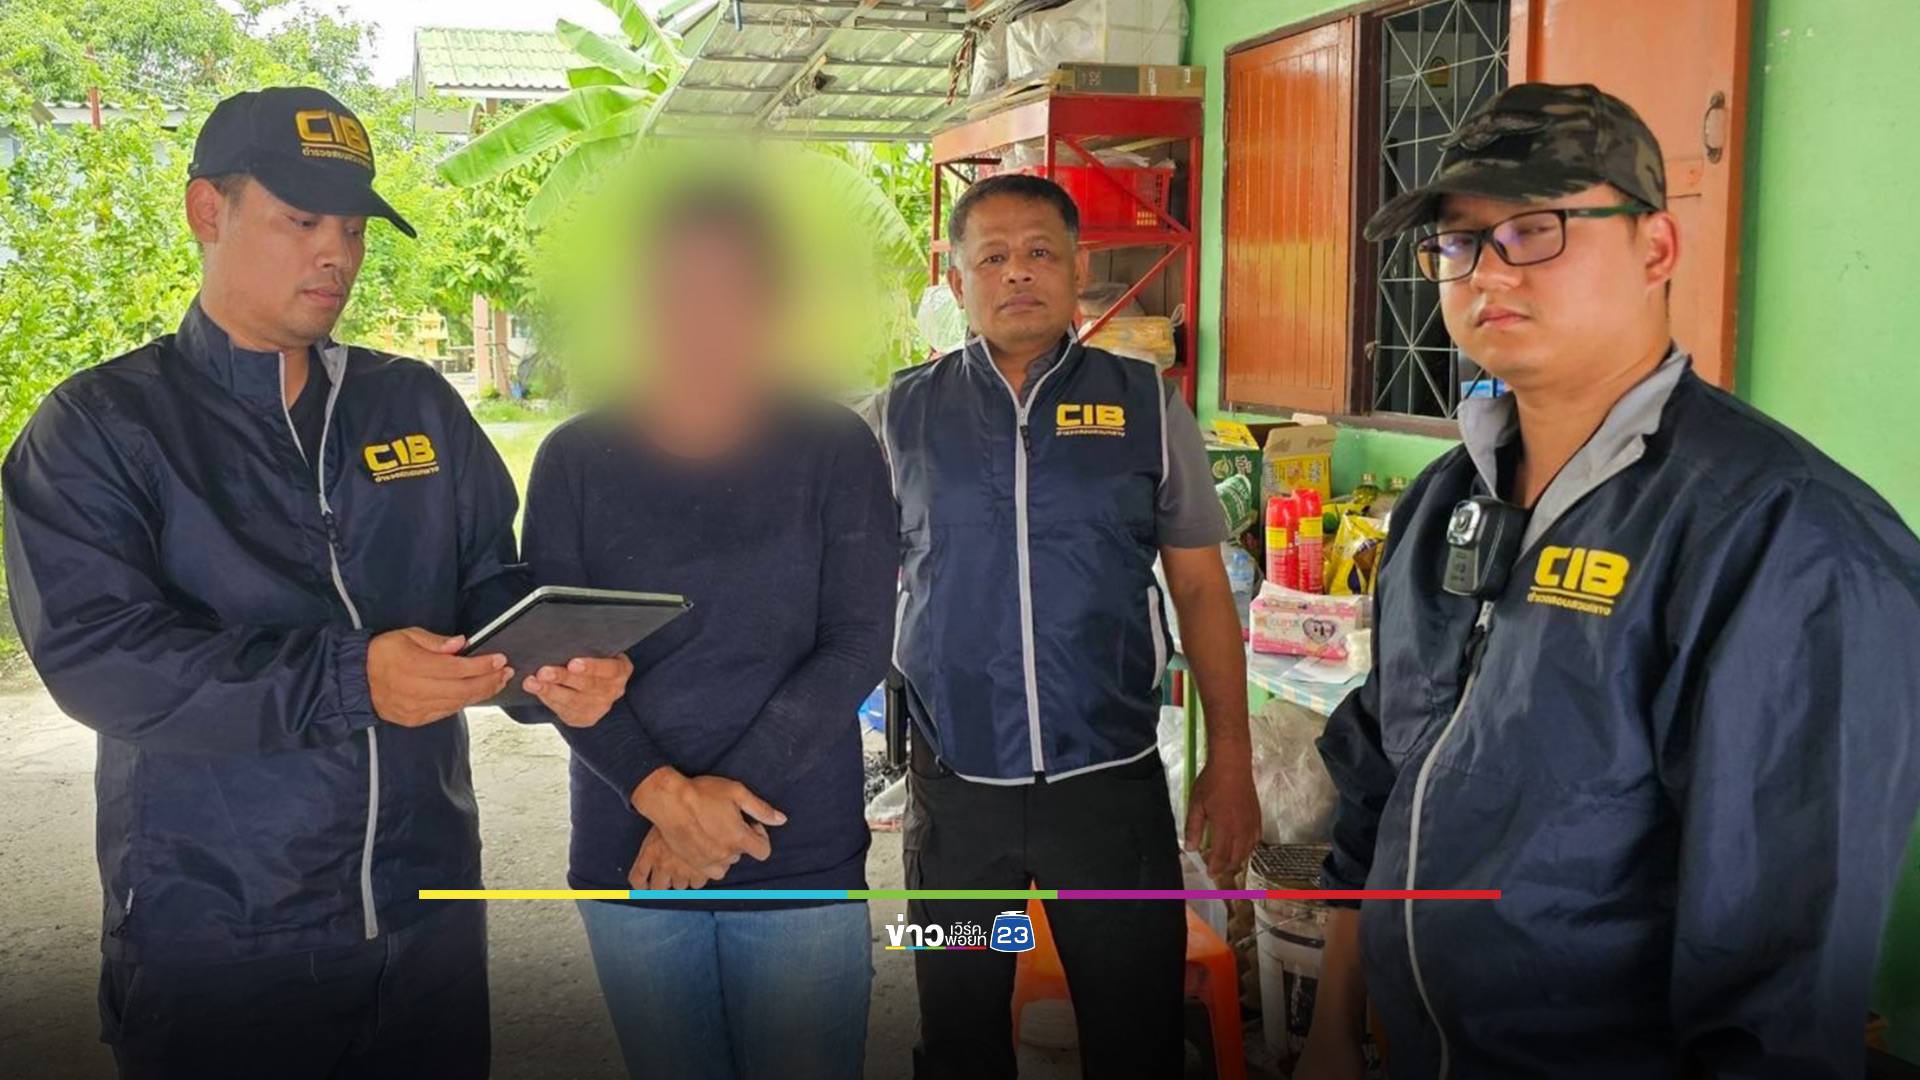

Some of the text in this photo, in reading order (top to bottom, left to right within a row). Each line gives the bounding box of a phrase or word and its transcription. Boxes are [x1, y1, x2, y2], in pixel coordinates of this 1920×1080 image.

[295, 109, 370, 153] CIB
[1056, 404, 1126, 427] CIB
[364, 434, 435, 472] CIB
[1534, 545, 1630, 597] CIB
